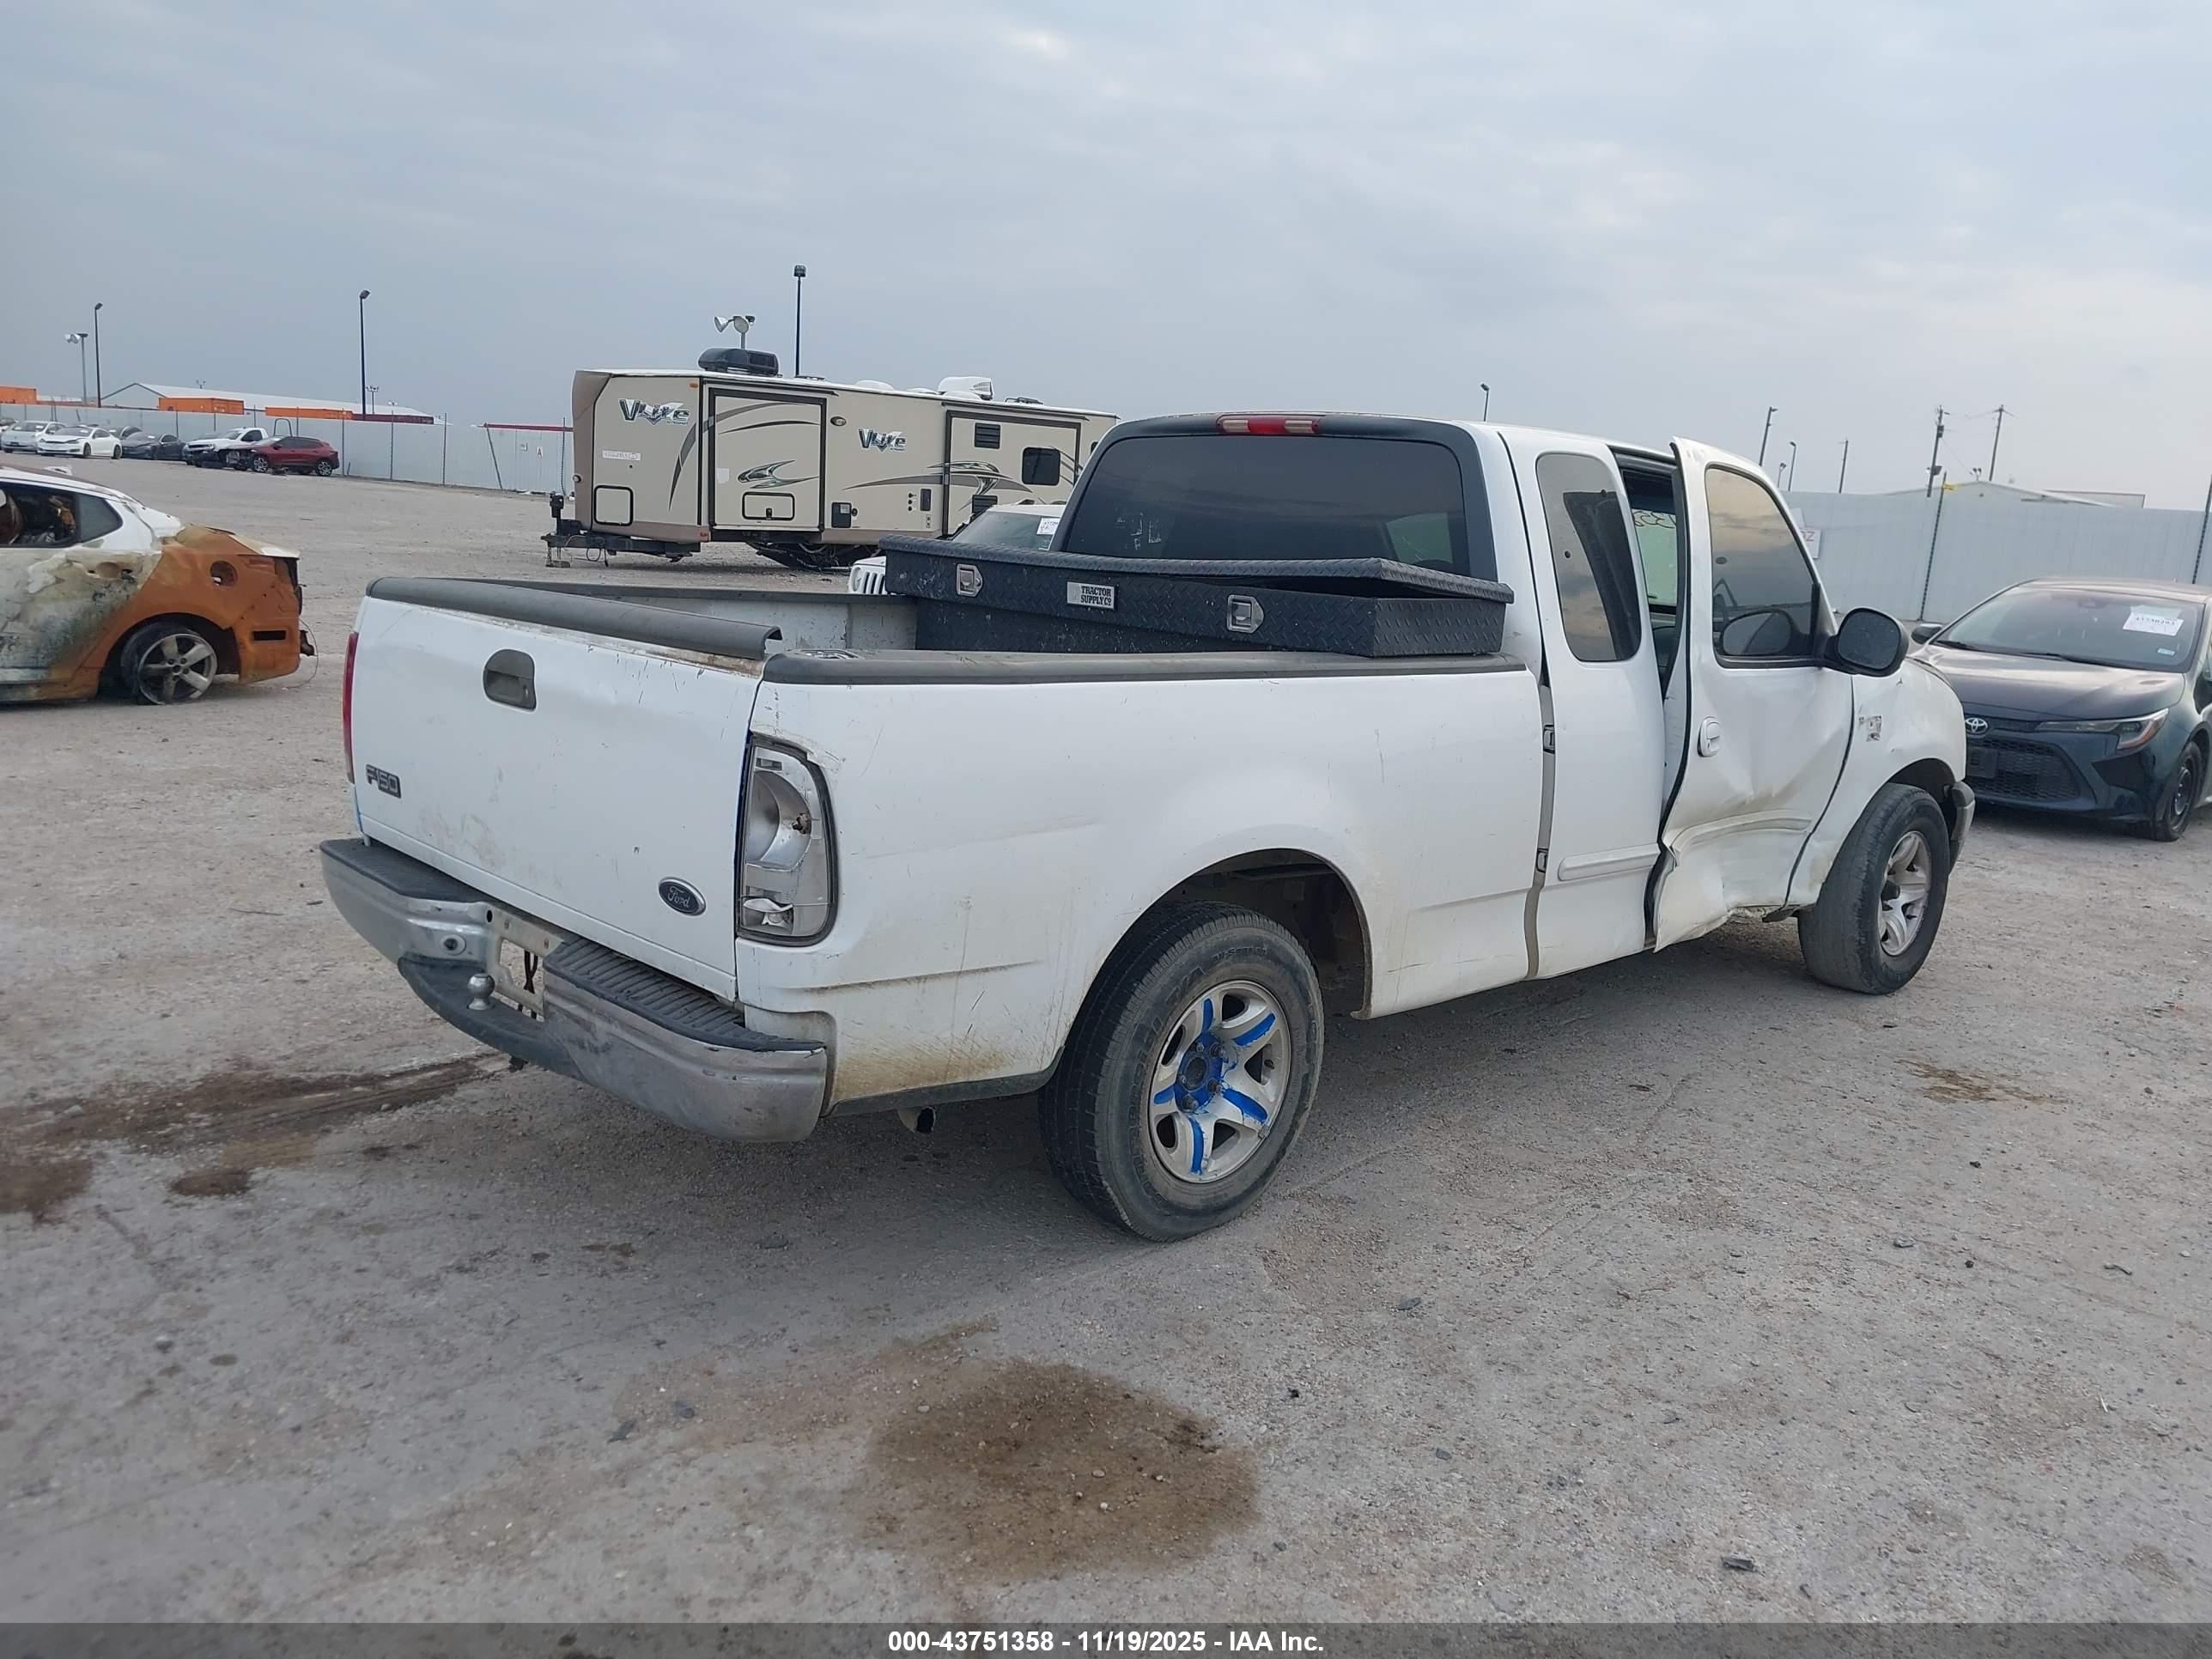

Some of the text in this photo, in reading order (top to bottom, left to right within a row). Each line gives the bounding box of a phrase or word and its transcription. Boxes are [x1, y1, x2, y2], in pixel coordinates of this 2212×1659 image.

[1081, 586, 1112, 597] TRACTOR
[1080, 594, 1104, 605] SUPPLY
[667, 885, 690, 908] Ford
